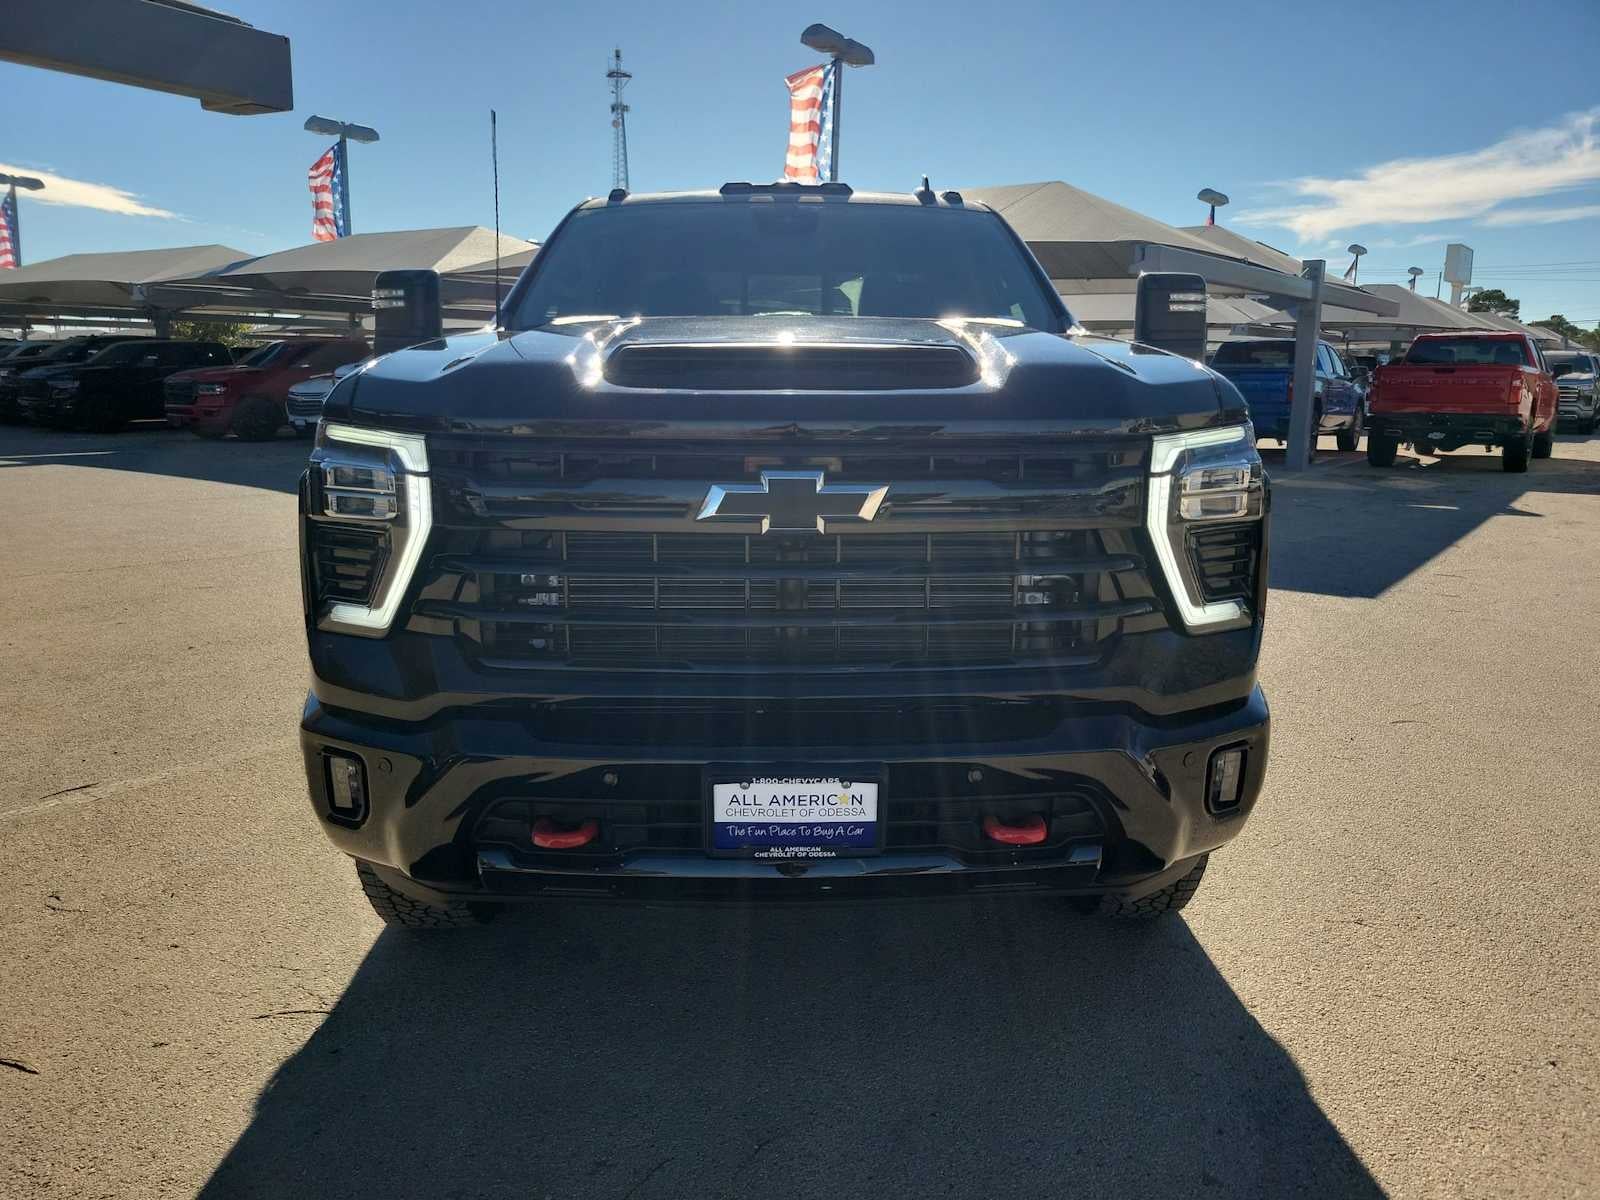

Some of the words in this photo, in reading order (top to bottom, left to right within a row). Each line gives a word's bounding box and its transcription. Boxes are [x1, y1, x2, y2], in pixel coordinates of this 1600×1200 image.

[729, 794, 763, 806] ALL
[725, 808, 796, 817] CHEVROLET
[799, 808, 815, 817] OF
[818, 807, 866, 816] ODESSA
[727, 825, 745, 836] The
[748, 826, 766, 836] Fun
[768, 825, 796, 836] Place
[799, 826, 811, 836] To
[813, 825, 834, 839] Buy
[835, 826, 844, 836] A
[846, 825, 865, 836] Car
